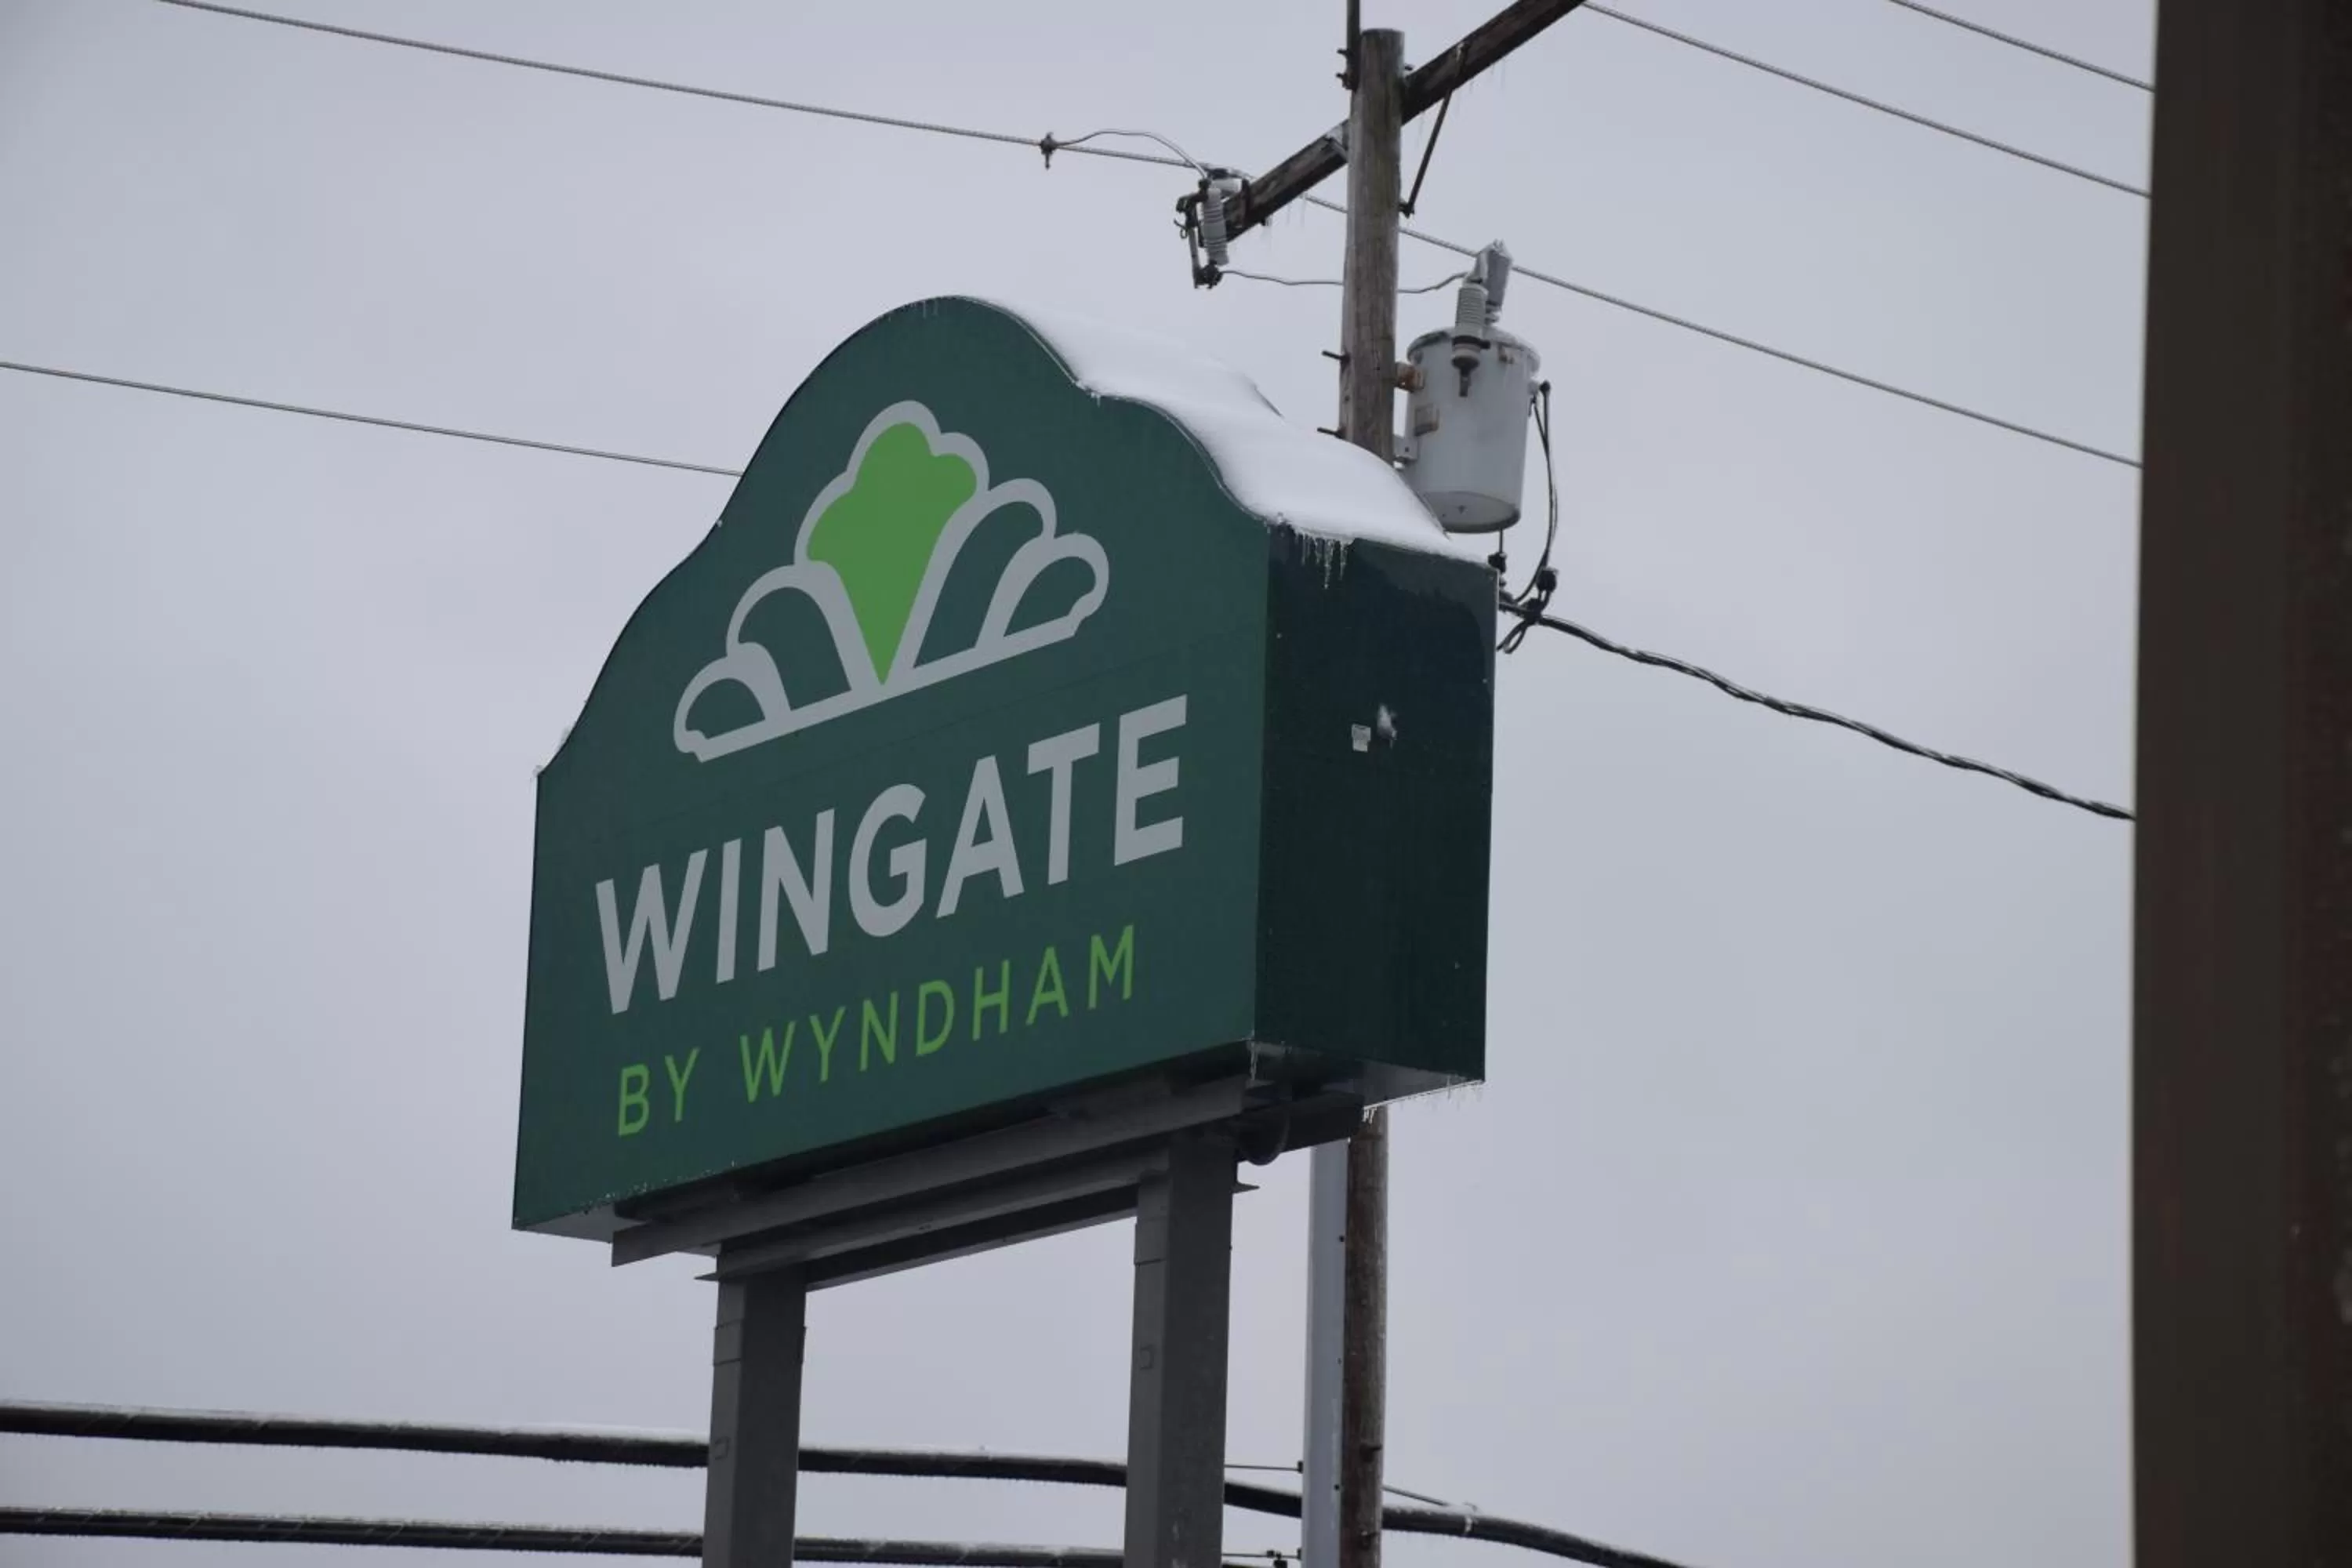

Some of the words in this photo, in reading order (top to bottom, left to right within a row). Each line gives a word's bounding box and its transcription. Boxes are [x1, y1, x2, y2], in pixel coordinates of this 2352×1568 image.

[596, 695, 1187, 1014] WINGATE
[618, 1047, 700, 1136] BY
[739, 925, 1134, 1102] WYNDHAM
